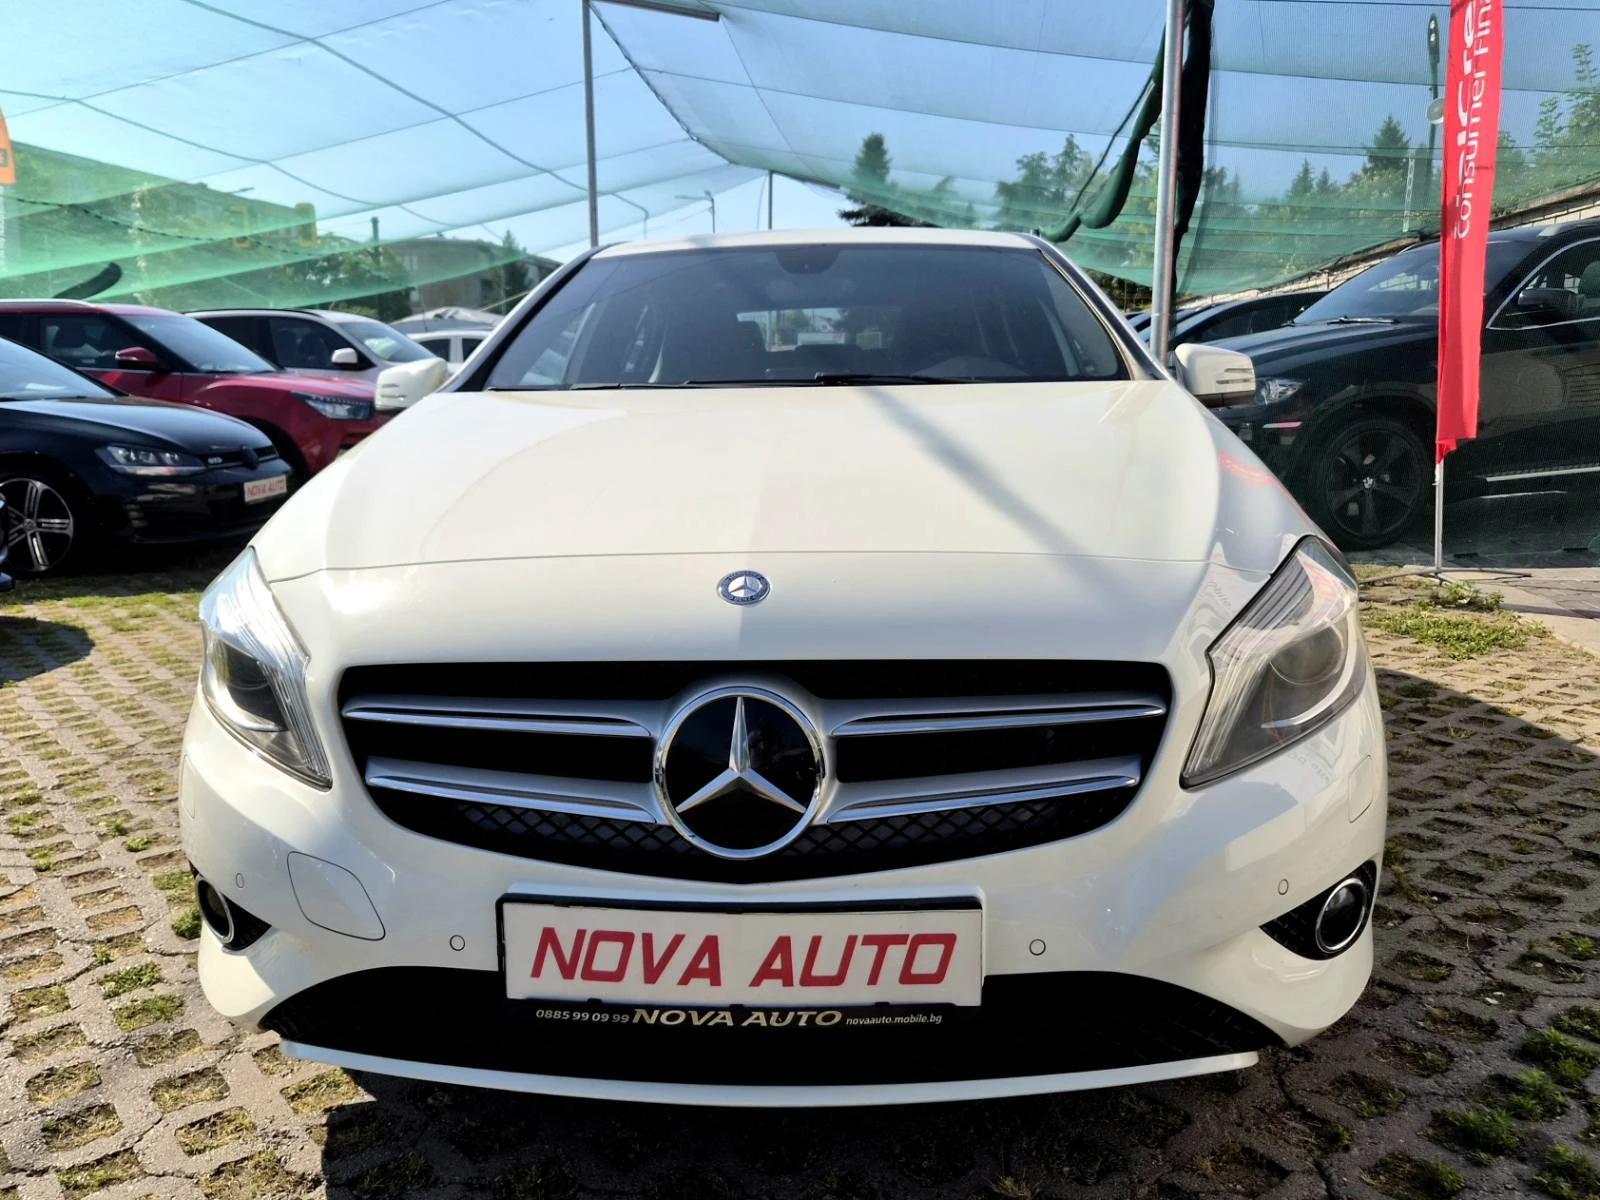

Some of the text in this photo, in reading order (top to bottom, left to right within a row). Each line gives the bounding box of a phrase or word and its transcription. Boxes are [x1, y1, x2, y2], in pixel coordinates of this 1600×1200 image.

[530, 927, 958, 988] NOVA AUTO
[536, 1008, 943, 1027] 0885 99 09 99 NOVA AUTO novaauto.mobile.bg
